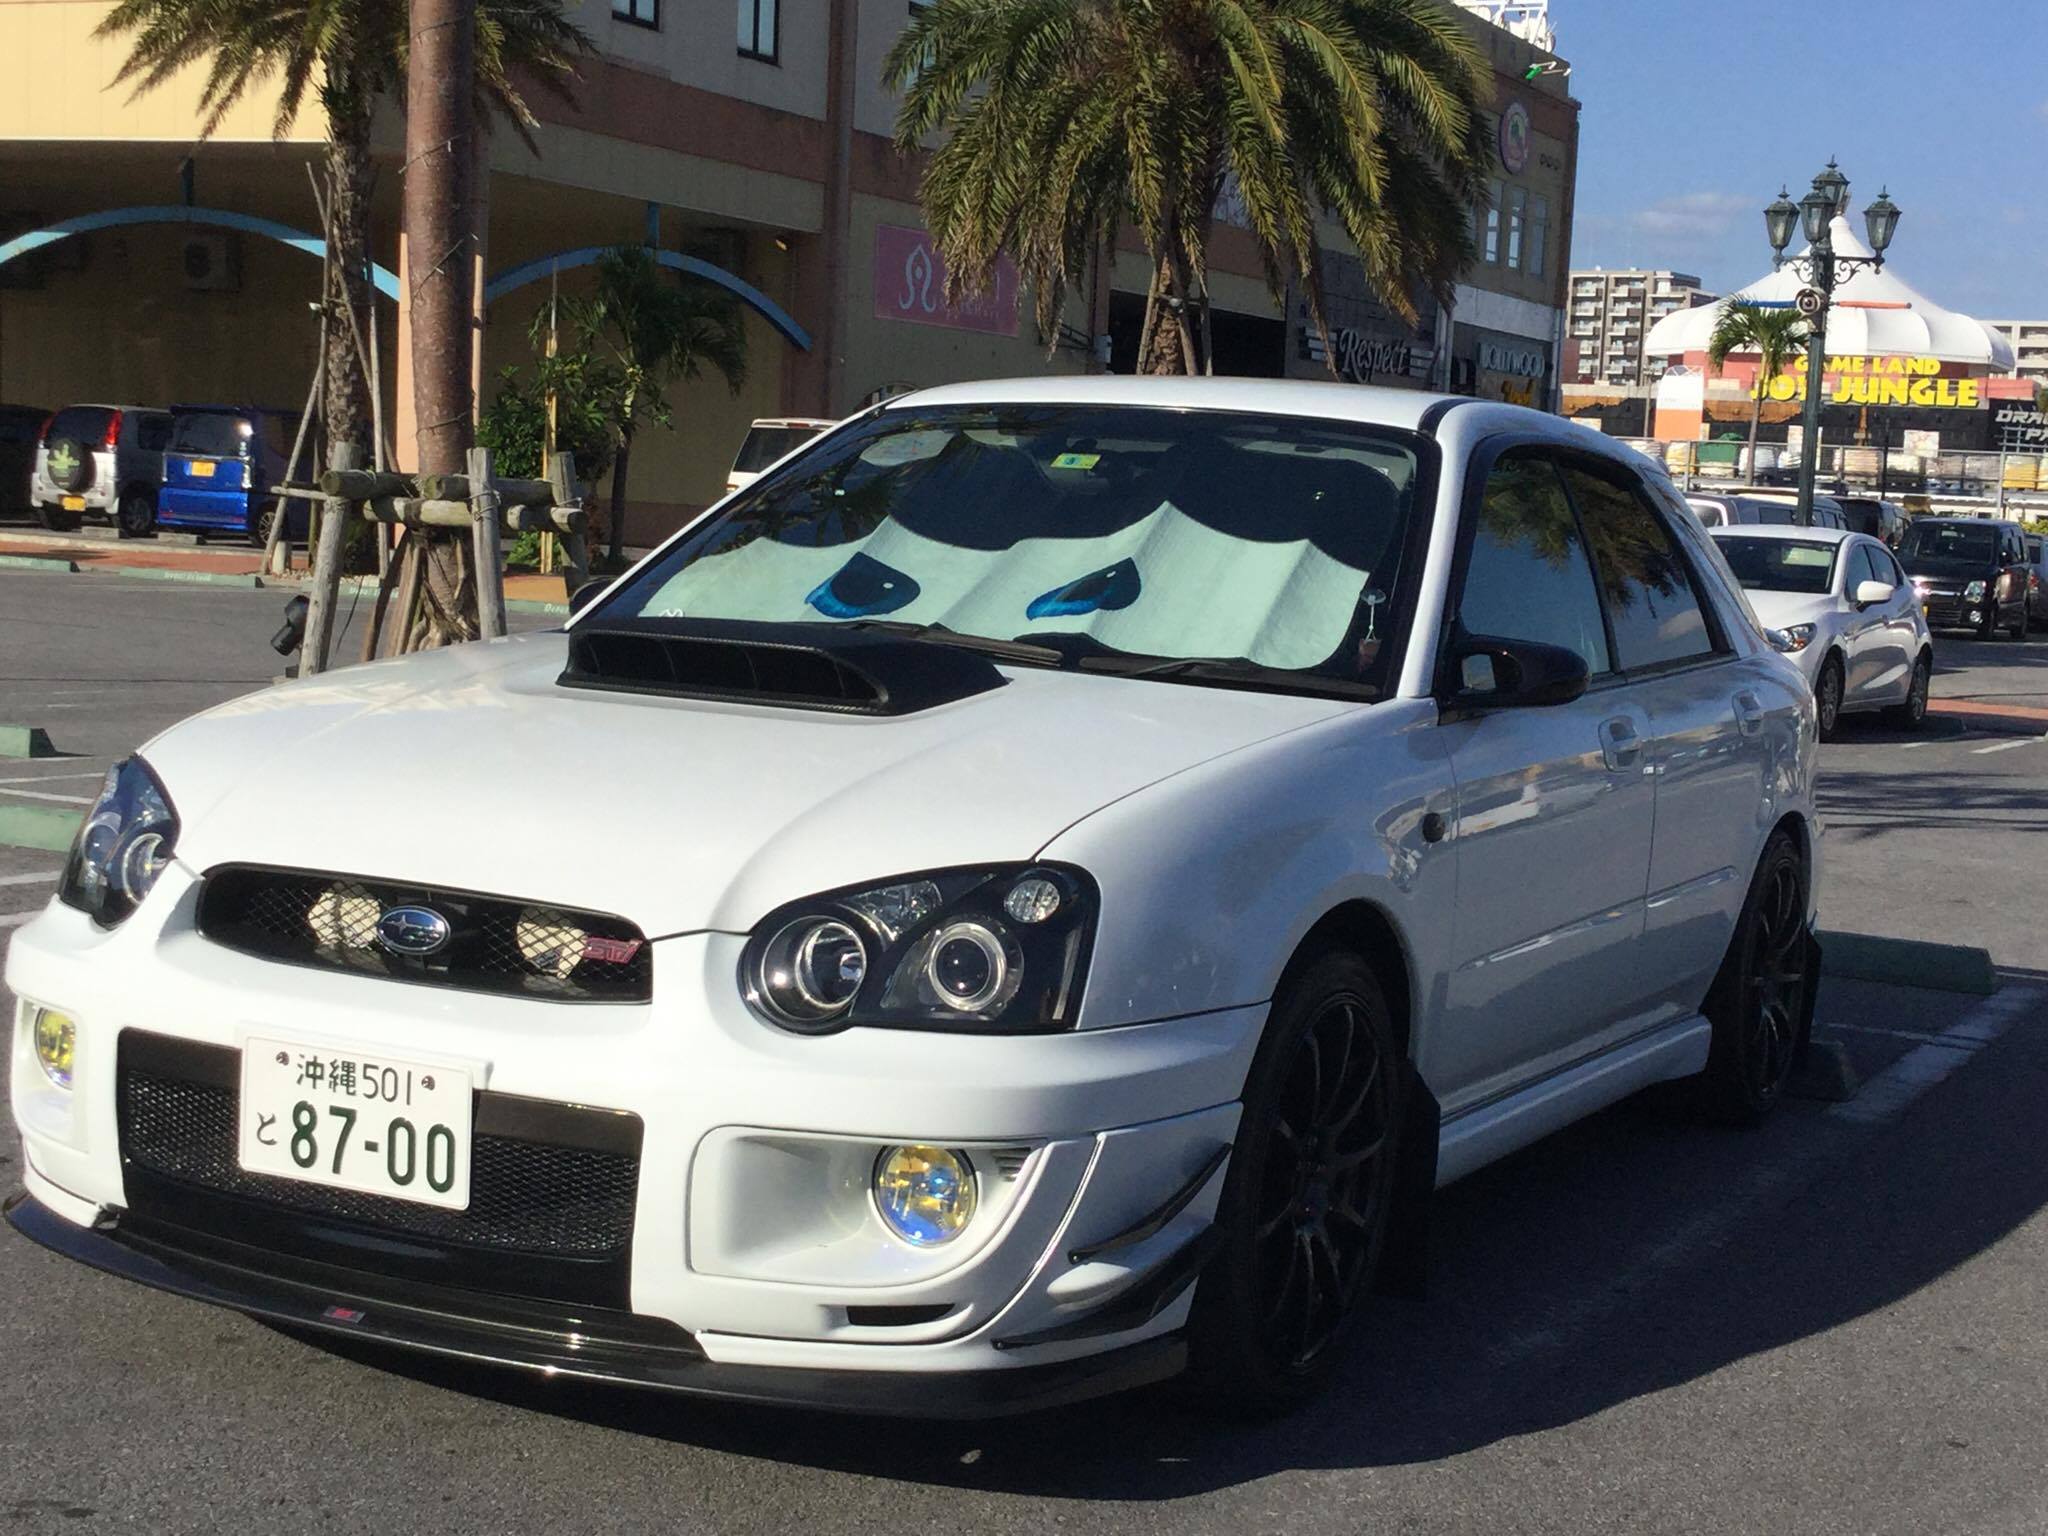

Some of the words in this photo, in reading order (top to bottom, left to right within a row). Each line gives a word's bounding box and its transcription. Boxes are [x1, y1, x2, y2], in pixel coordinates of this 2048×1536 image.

[1340, 328, 1407, 384] Respect
[1794, 355, 1863, 373] GME
[1873, 357, 1941, 375] LAND
[1832, 374, 1979, 407] JUNGLE
[256, 1112, 278, 1146] と
[290, 1099, 456, 1193] 87-00
